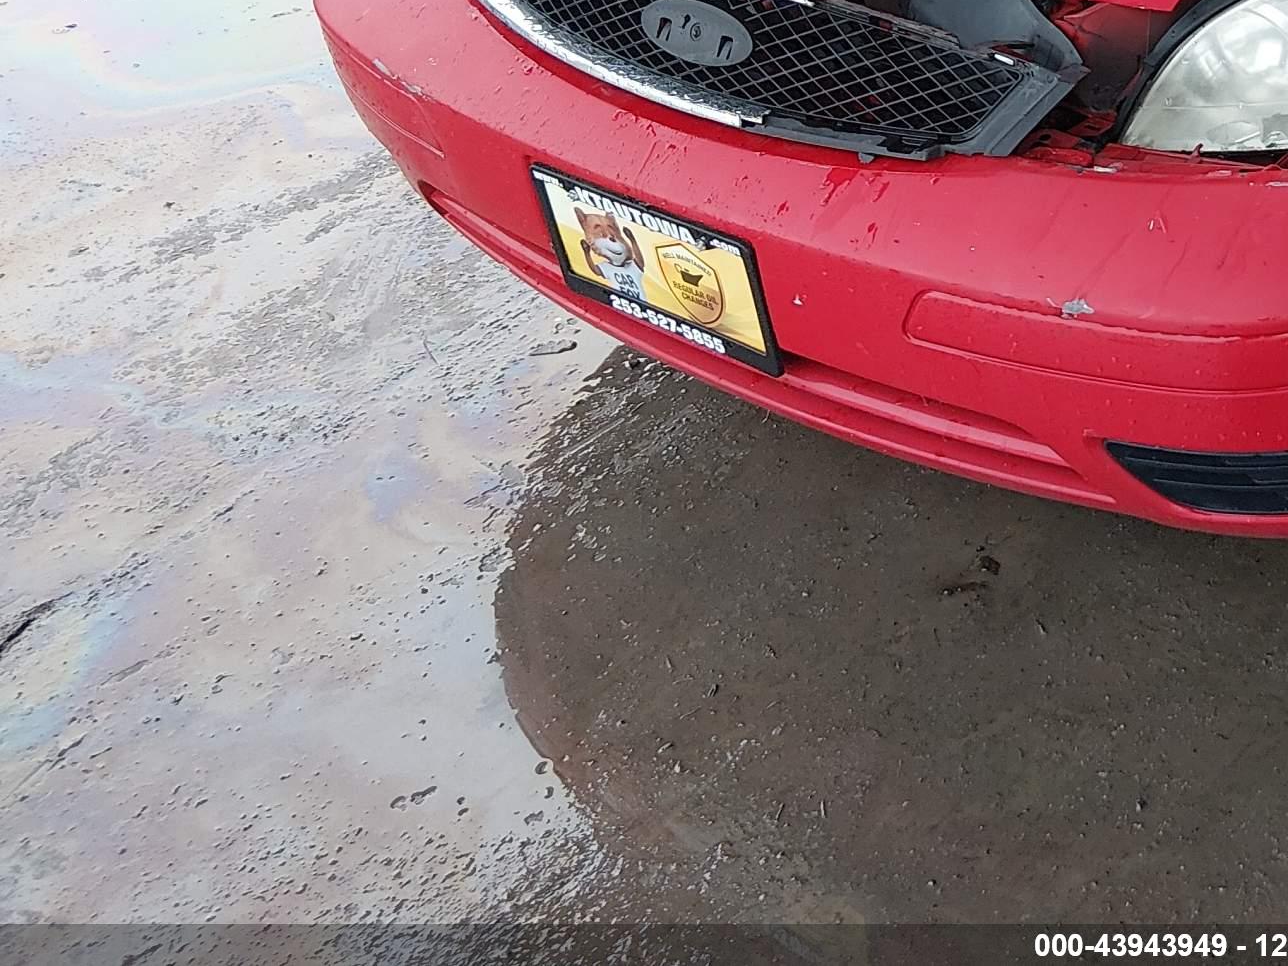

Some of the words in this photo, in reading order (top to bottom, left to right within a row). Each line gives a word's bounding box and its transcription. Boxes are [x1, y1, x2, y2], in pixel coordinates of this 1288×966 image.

[614, 272, 639, 290] CAR
[672, 280, 705, 299] REGULAR
[609, 294, 726, 354] 253-527-5855
